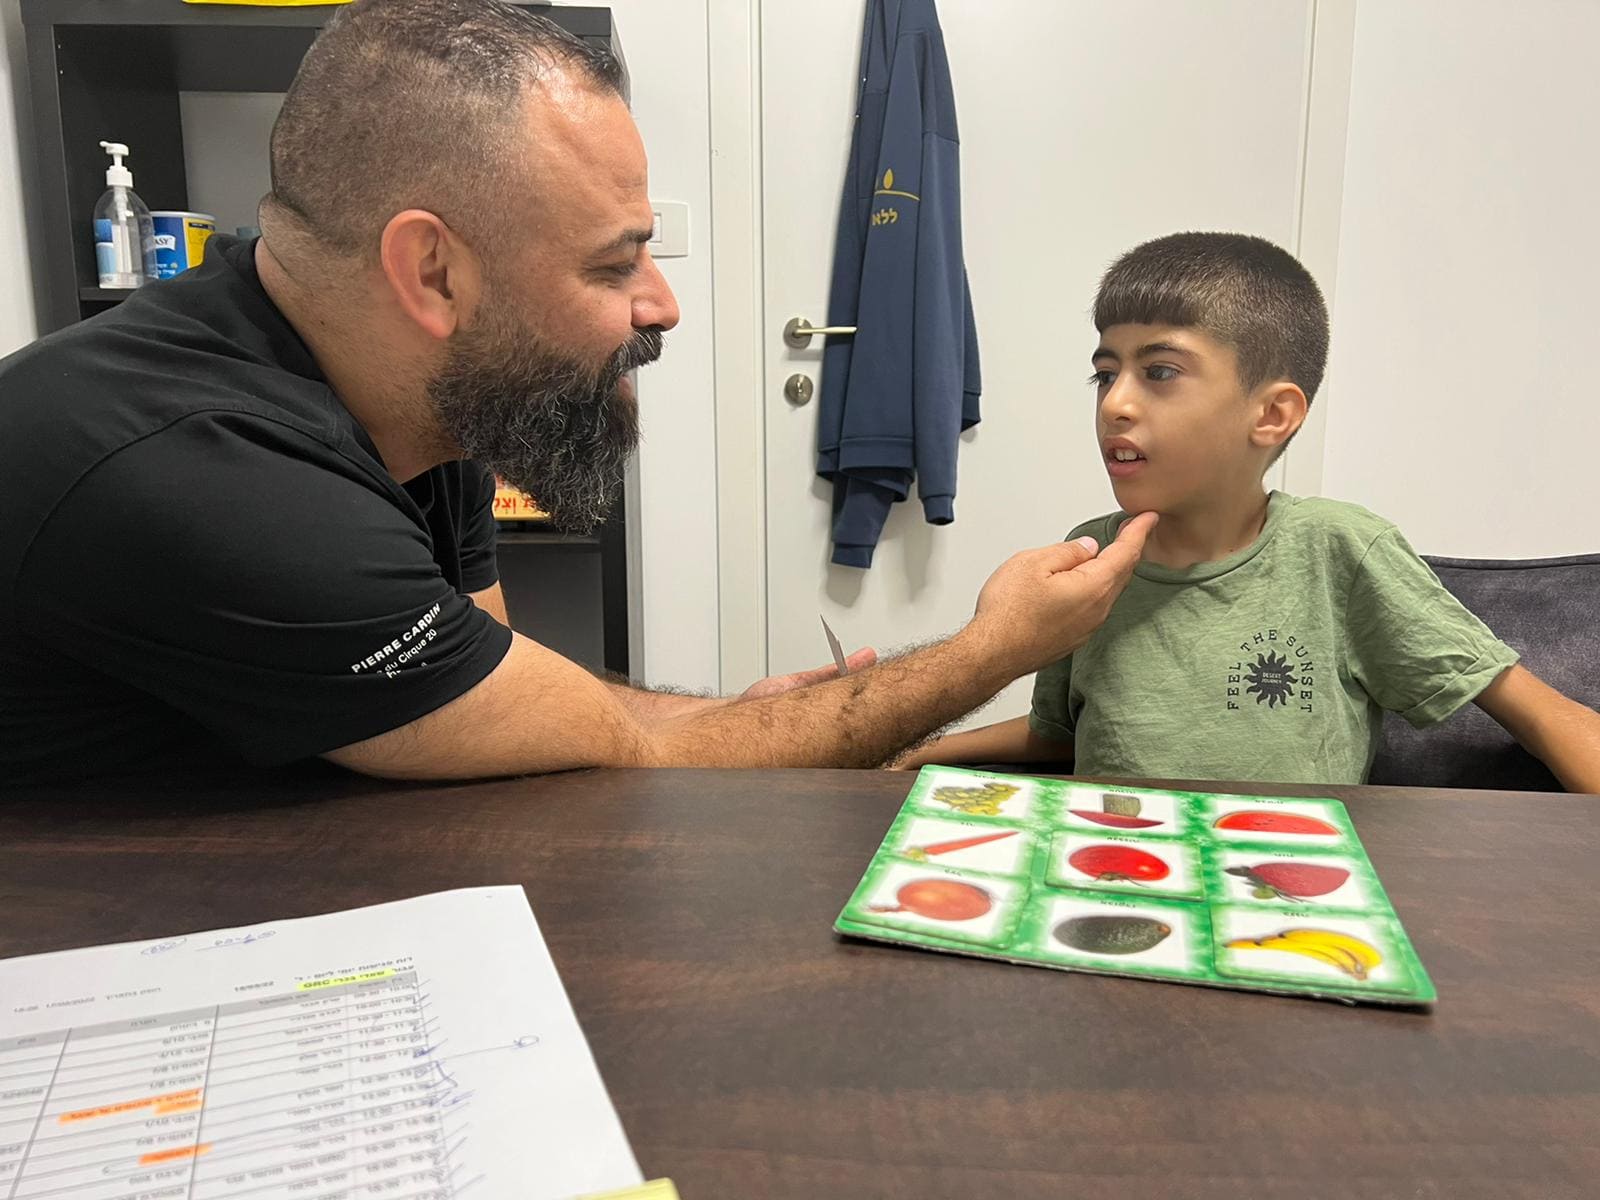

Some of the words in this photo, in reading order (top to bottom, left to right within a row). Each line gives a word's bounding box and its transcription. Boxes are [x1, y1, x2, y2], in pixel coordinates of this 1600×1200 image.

[351, 638, 402, 673] PIERRE
[402, 602, 441, 642] CARDIN
[384, 661, 398, 672] du
[398, 638, 427, 664] Cirque
[425, 628, 438, 641] 20
[1227, 661, 1242, 710] FEEL
[1240, 629, 1278, 652] THE
[1286, 635, 1314, 713] SUNSET
